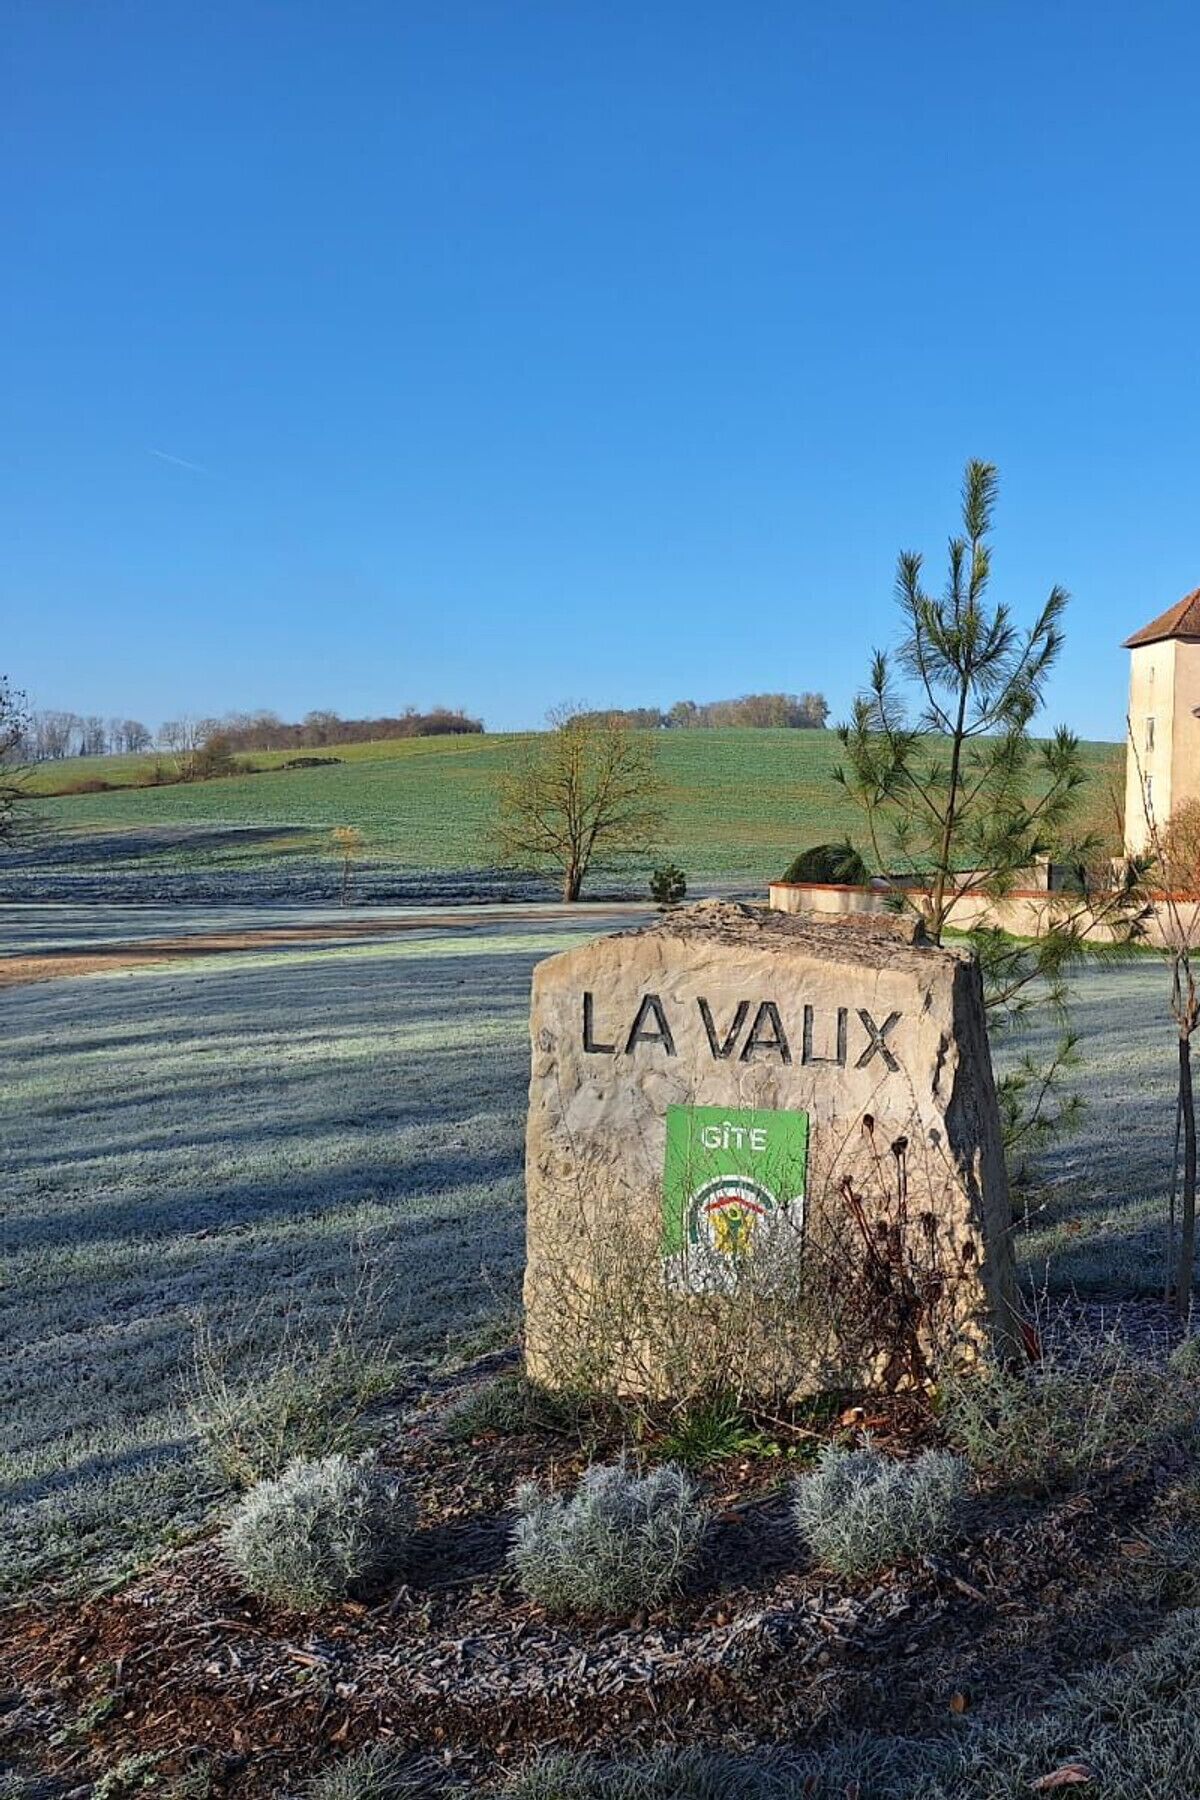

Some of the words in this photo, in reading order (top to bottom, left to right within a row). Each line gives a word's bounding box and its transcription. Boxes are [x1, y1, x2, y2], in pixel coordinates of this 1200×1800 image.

[583, 991, 678, 1057] LA
[696, 996, 903, 1072] VAUX
[702, 1121, 768, 1151] GÎTE
